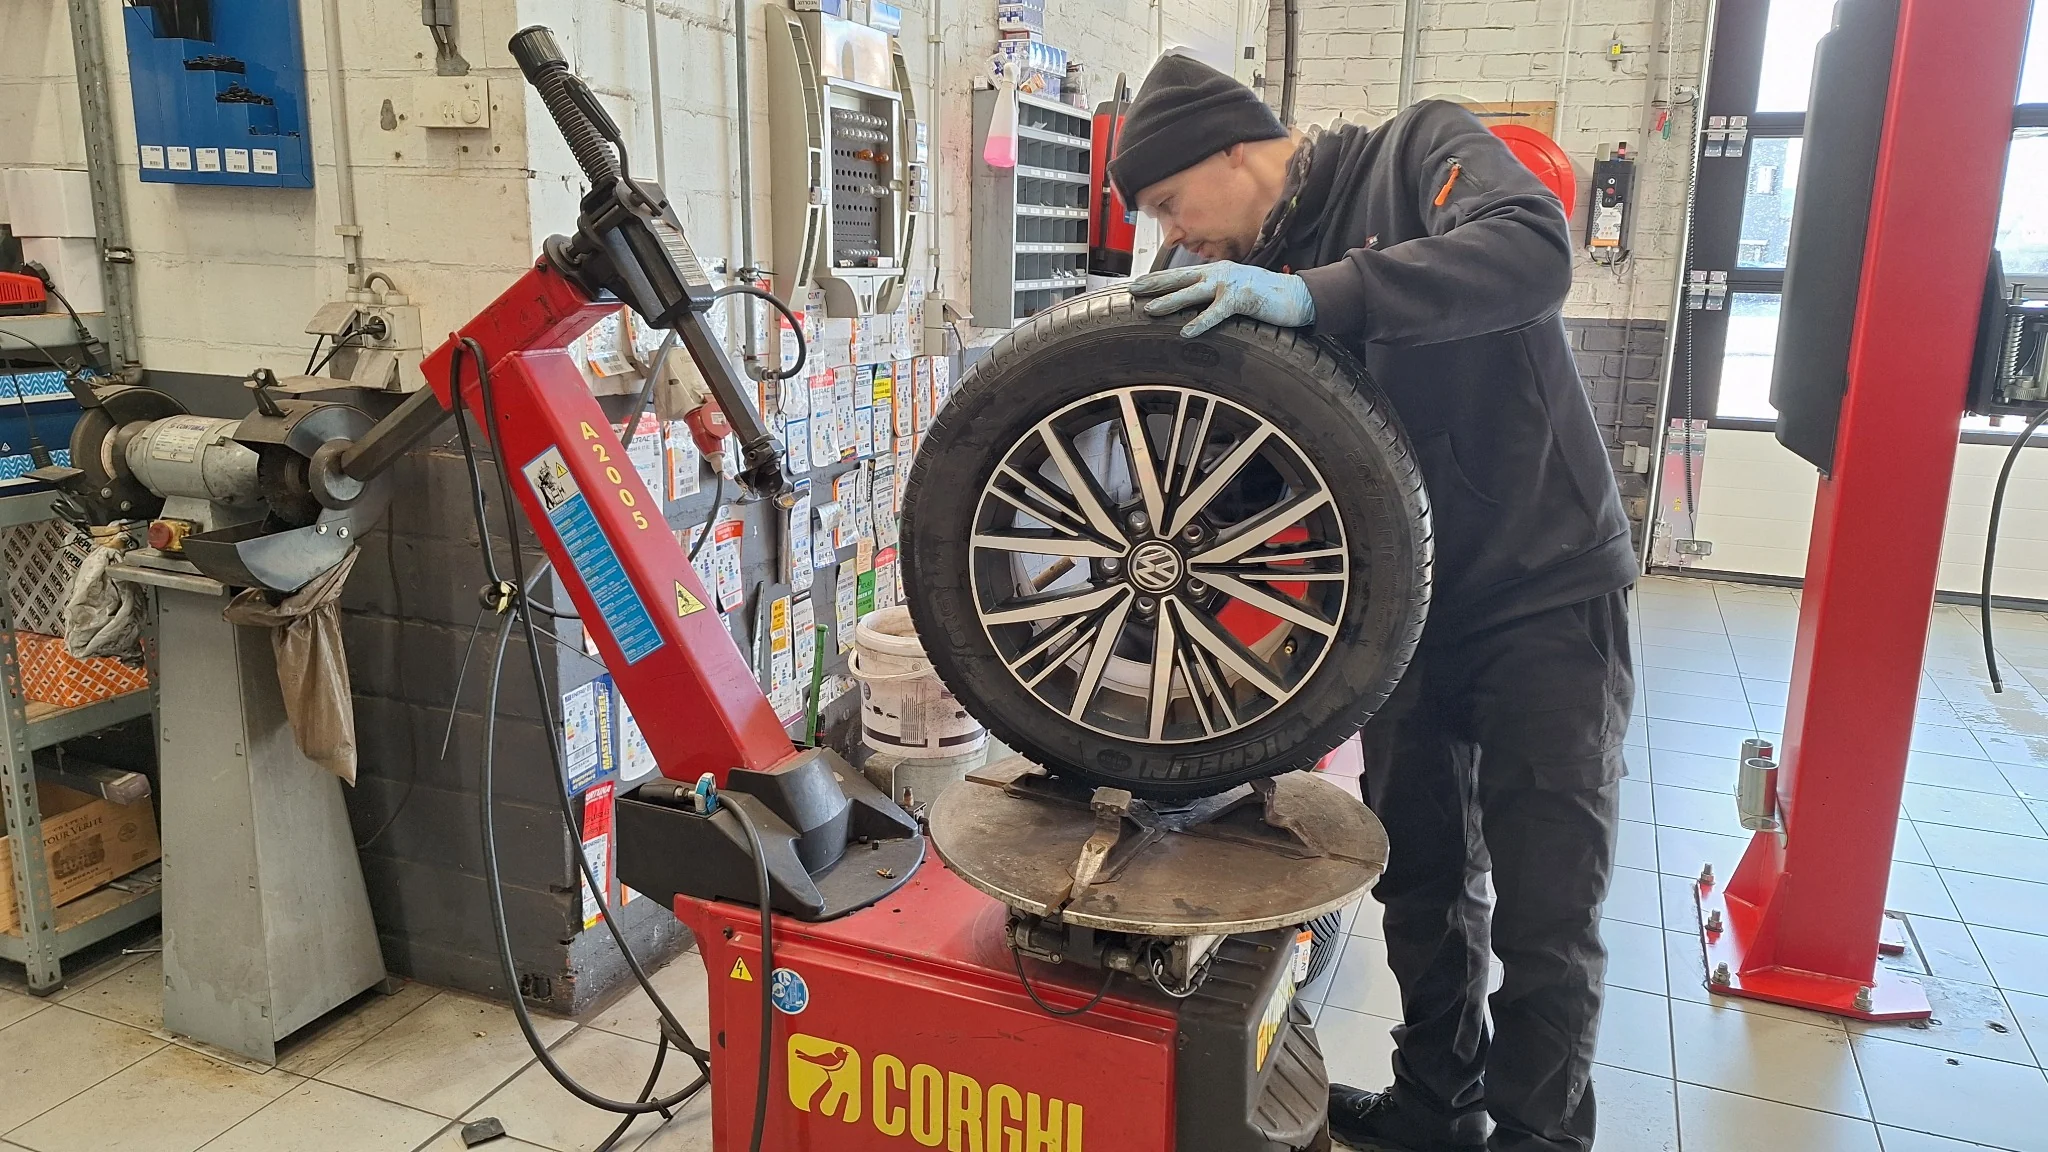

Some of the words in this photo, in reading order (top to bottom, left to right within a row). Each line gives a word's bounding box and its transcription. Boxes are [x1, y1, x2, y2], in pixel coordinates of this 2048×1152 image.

[56, 561, 72, 581] HEPU
[49, 572, 65, 593] HEPU
[35, 594, 50, 616] HEPU
[42, 583, 57, 605] HEPU
[28, 606, 42, 626] HEPU
[598, 693, 612, 771] MASTERSTEEL
[43, 830, 70, 847] TOUR
[1300, 949, 1309, 972] CEAT
[872, 1053, 1083, 1152] CORGHI
